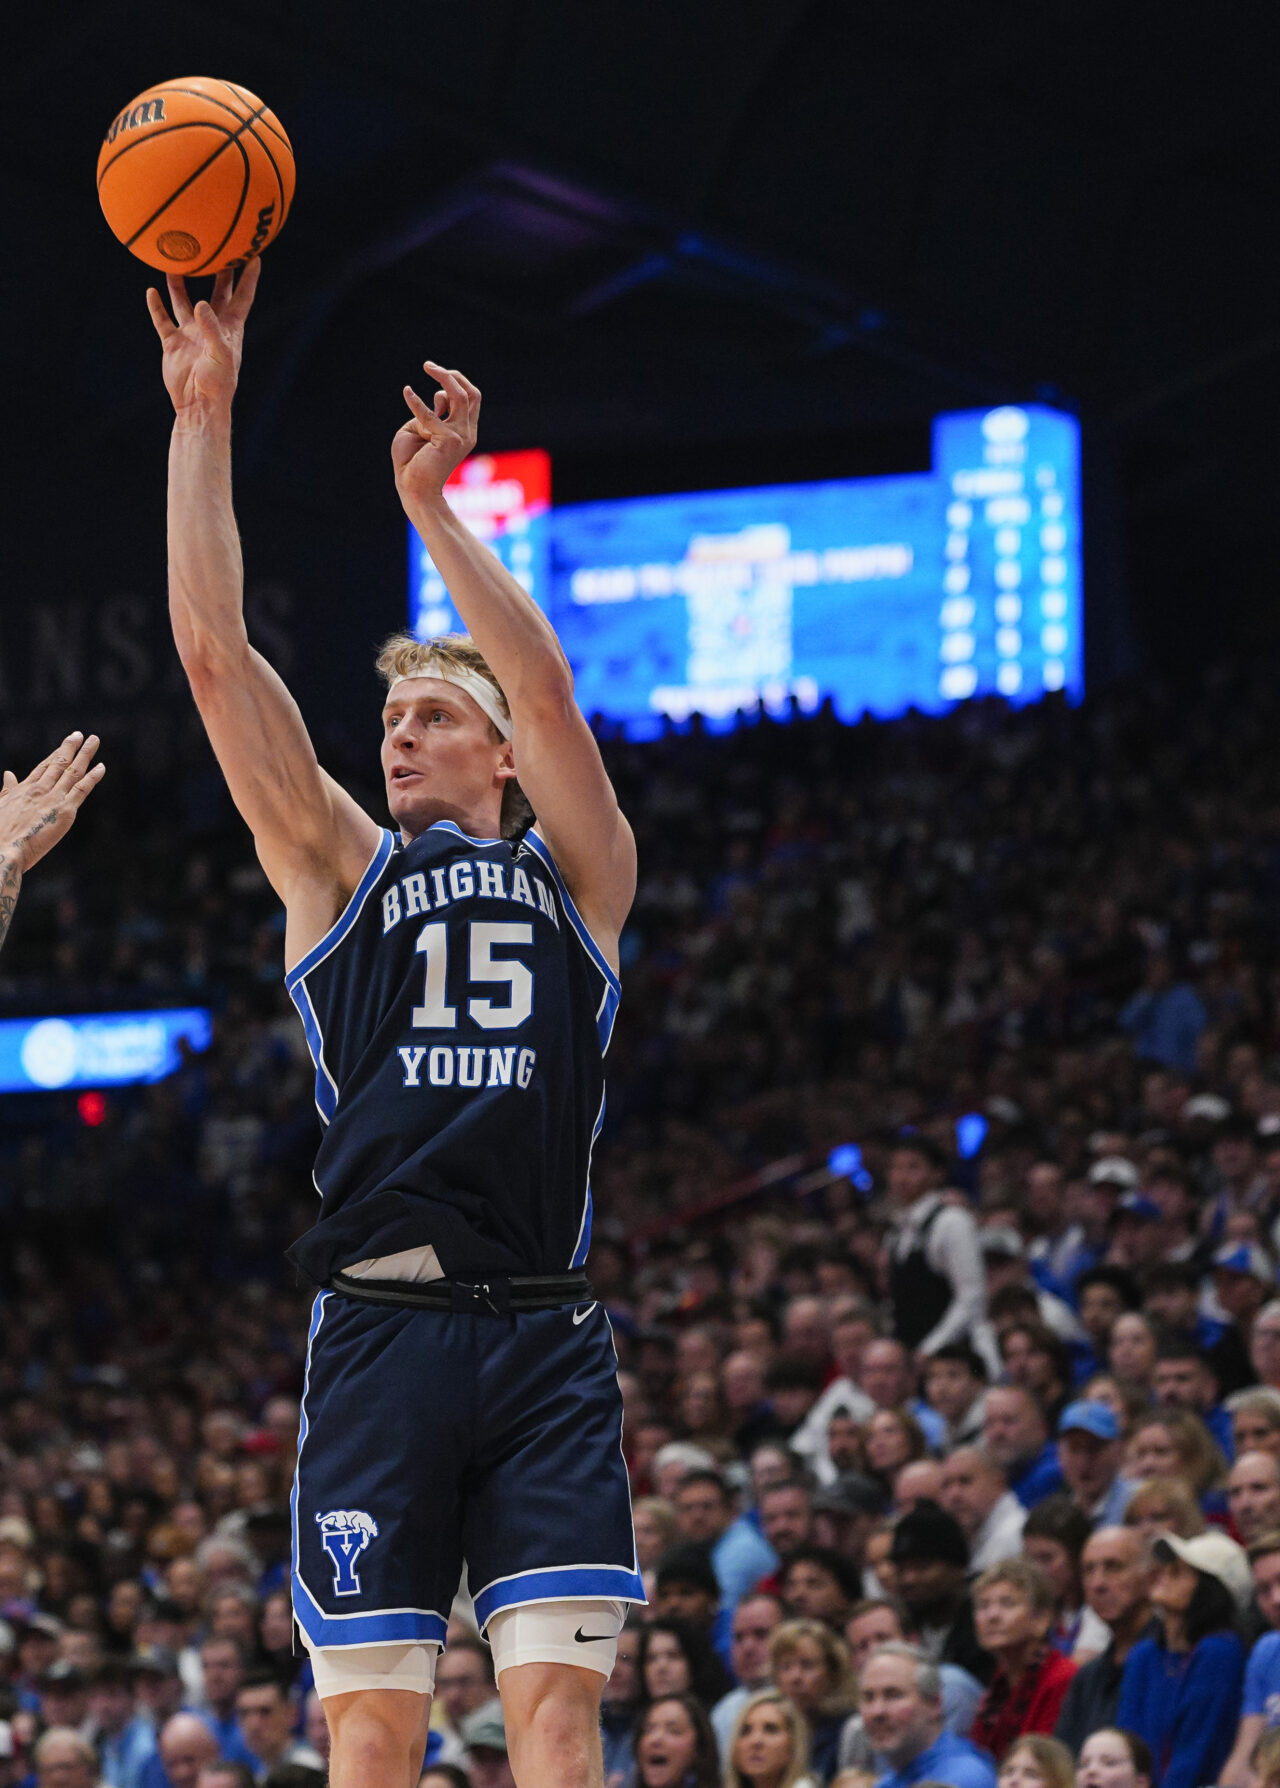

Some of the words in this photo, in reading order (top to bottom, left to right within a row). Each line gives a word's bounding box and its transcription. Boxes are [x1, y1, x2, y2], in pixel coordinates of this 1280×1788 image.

[381, 858, 560, 937] BRIGHAM
[410, 919, 535, 1030] 15
[396, 1044, 537, 1090] YOUNG
